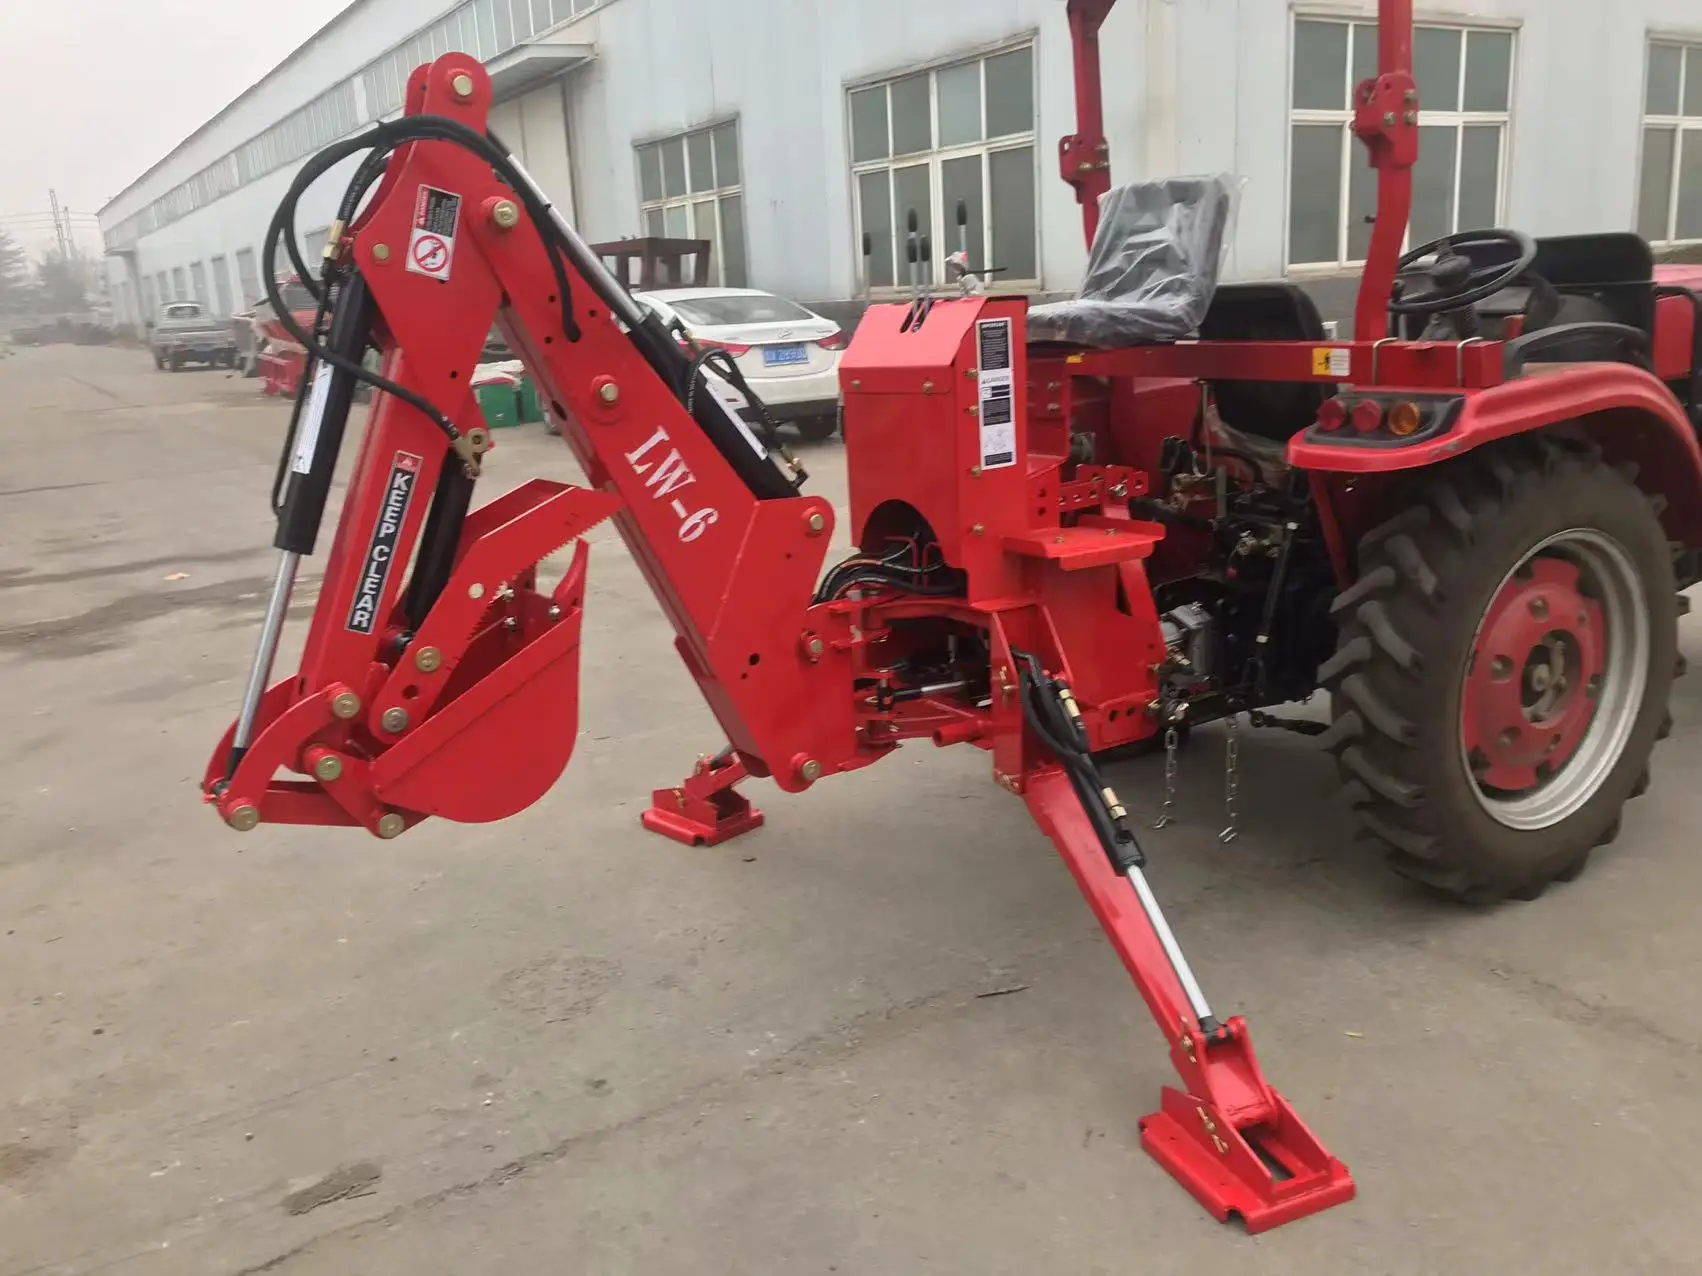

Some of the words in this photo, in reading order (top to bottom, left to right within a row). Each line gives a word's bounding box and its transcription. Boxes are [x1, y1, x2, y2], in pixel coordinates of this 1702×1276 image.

[378, 472, 412, 538] KEEP
[624, 425, 719, 543] LW-6
[352, 545, 390, 628] CLEAR
